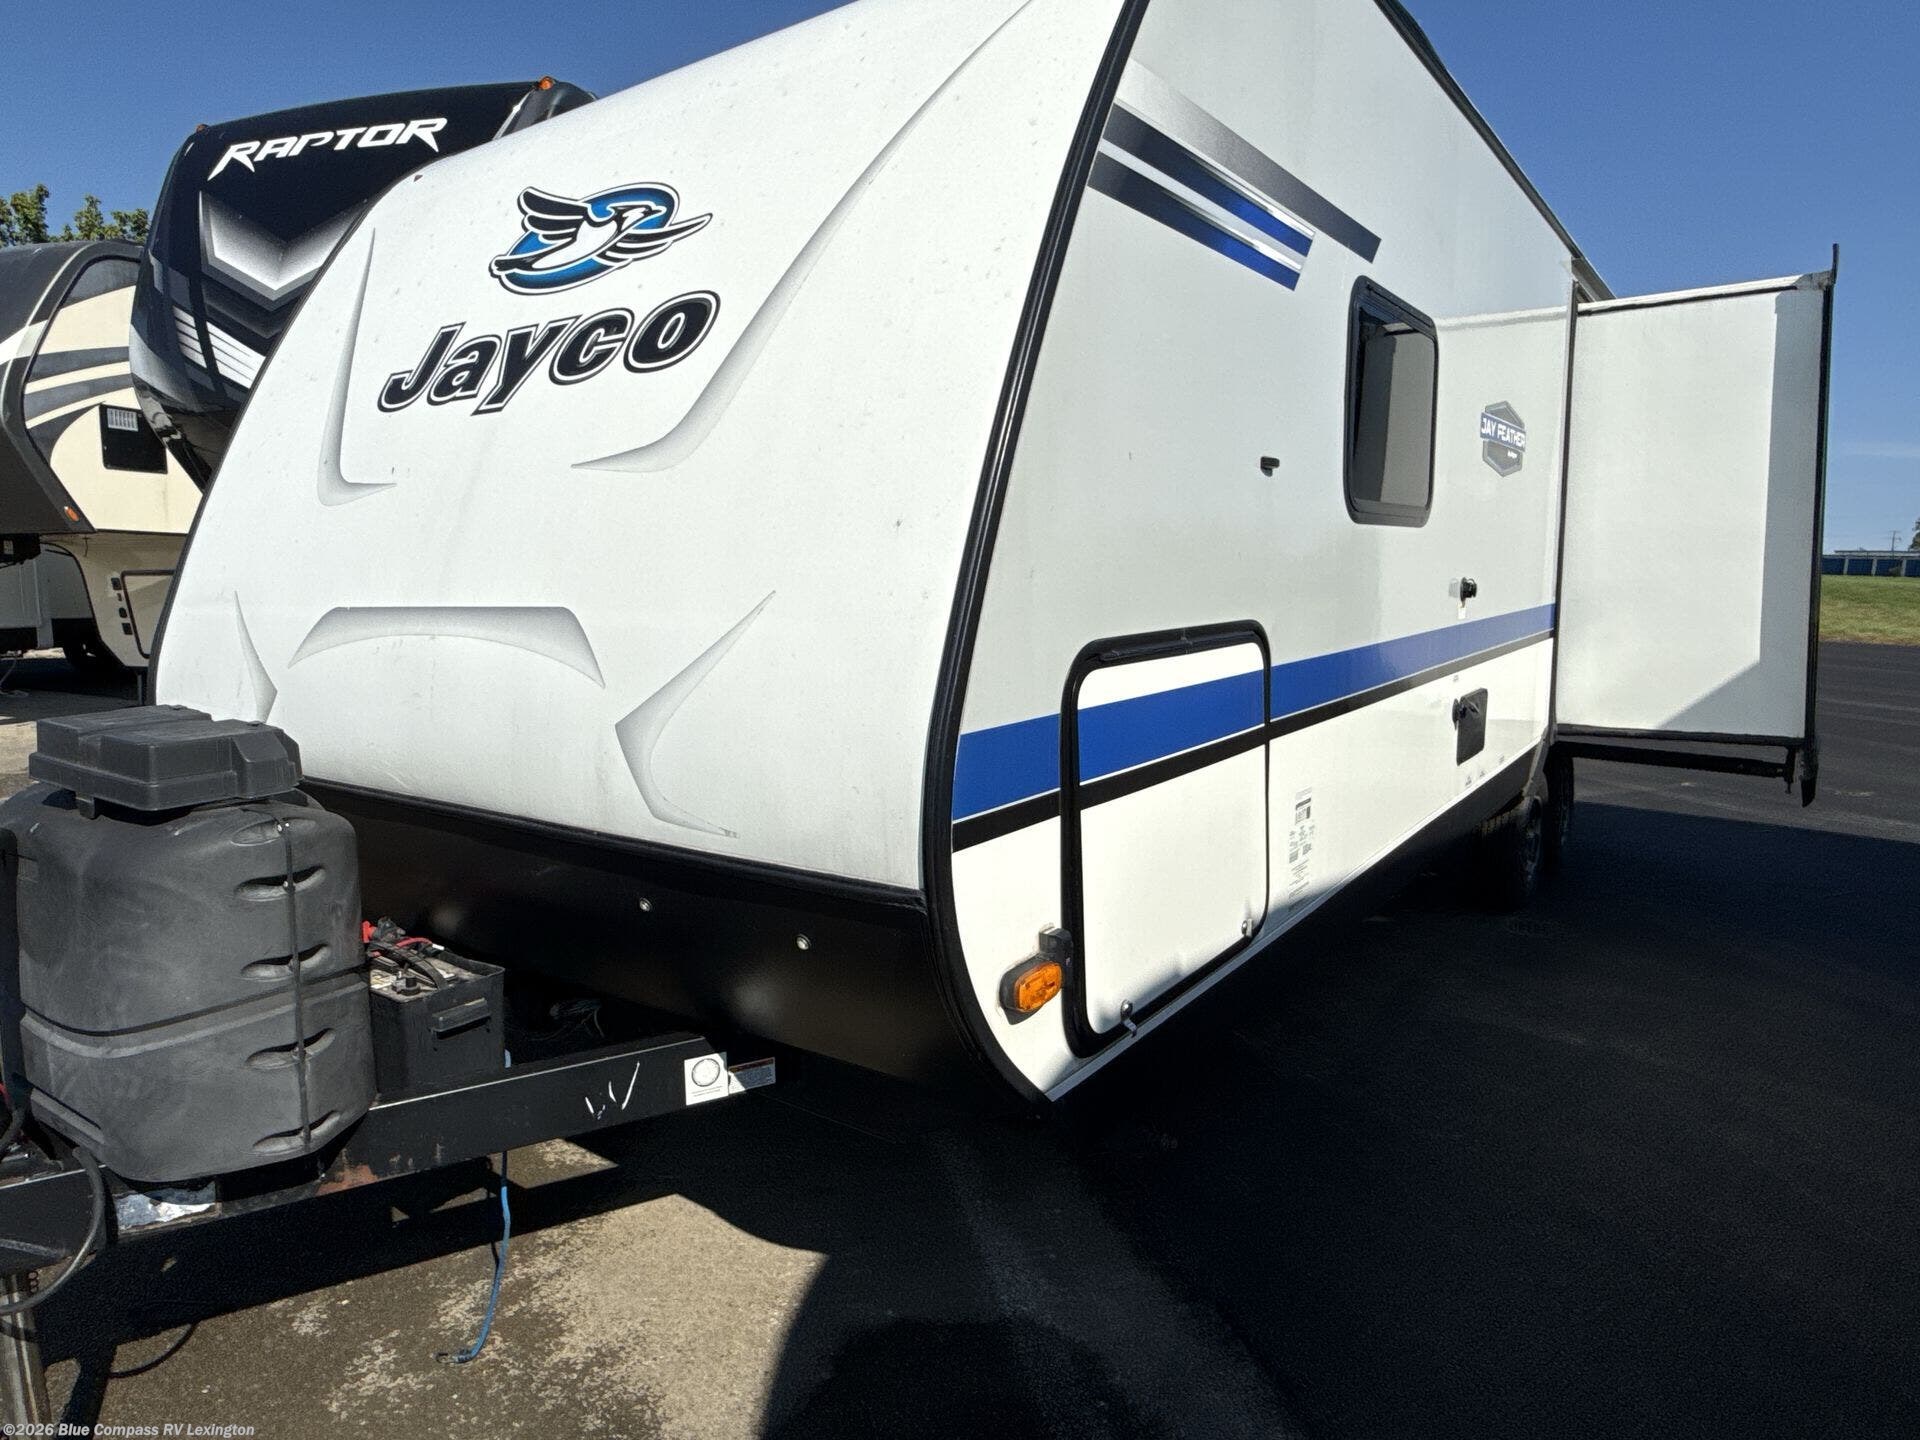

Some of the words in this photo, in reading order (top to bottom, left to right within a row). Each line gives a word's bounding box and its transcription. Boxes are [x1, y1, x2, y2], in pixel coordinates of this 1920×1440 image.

[207, 117, 448, 181] RAPTOR
[377, 290, 721, 416] Jayco
[1481, 417, 1497, 438] JAY
[1497, 424, 1526, 449] FEATHER
